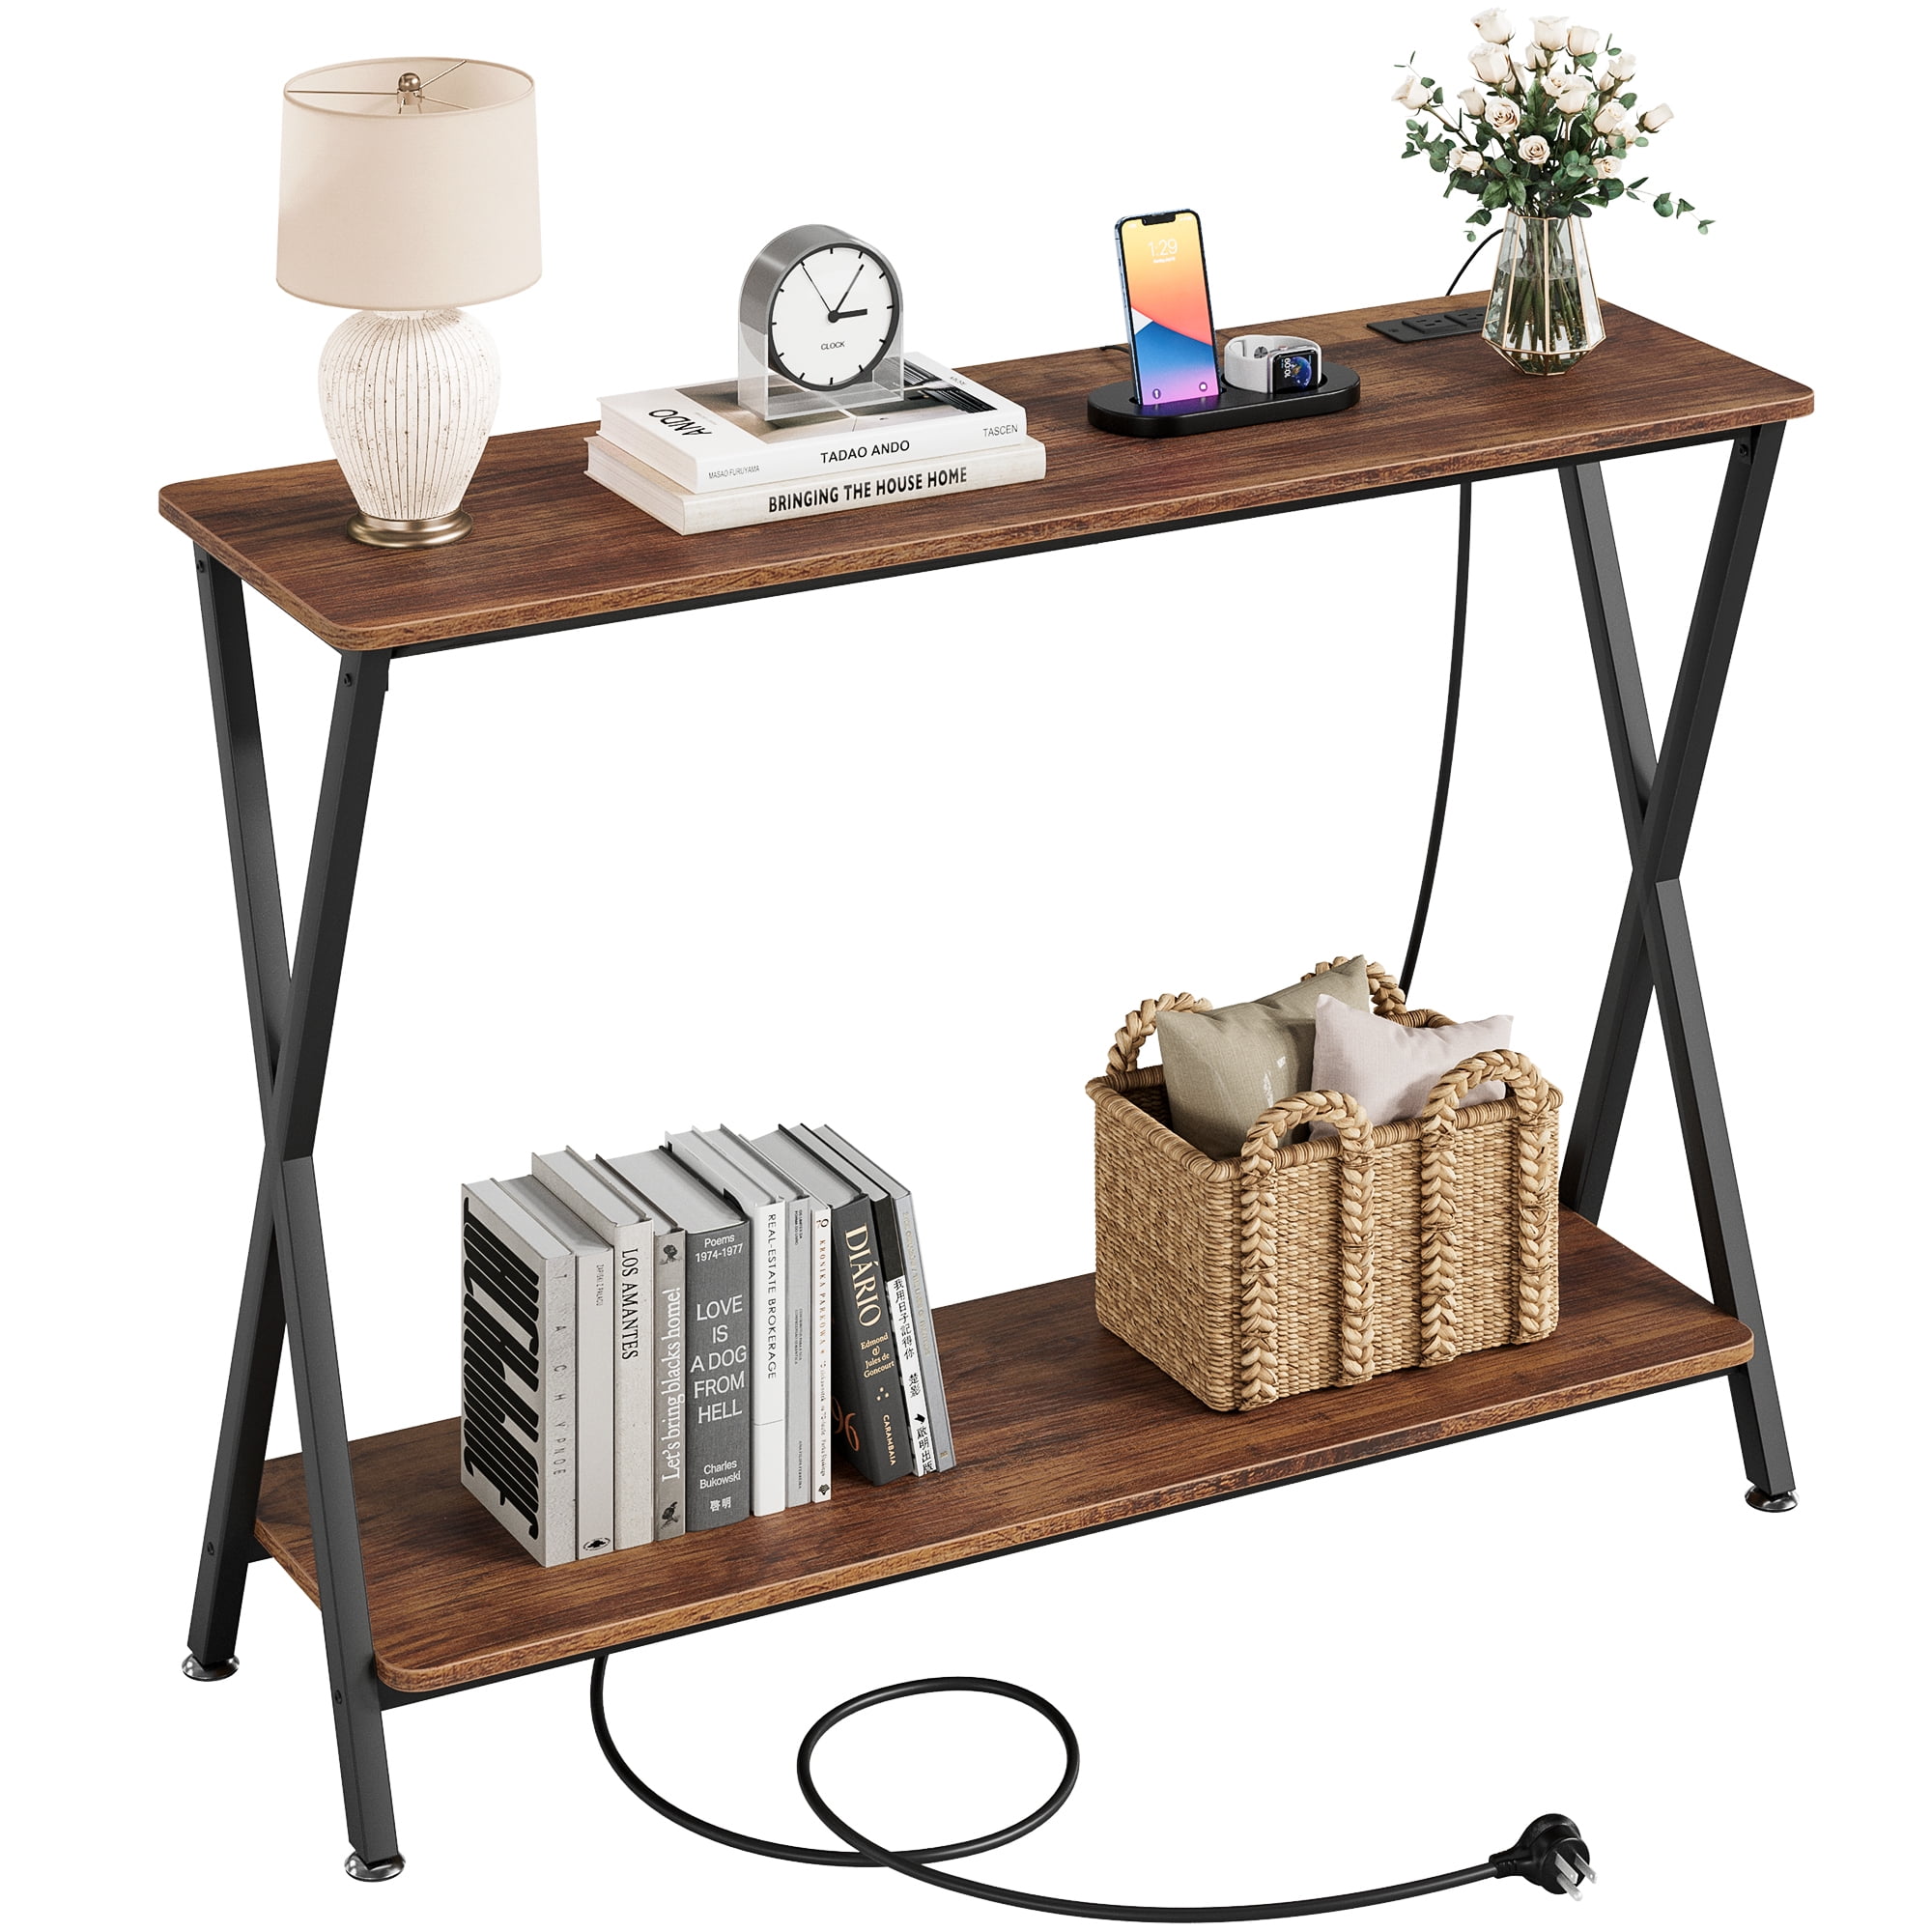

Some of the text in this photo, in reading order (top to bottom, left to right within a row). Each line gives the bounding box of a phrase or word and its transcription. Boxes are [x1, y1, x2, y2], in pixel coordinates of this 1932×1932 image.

[1147, 239, 1179, 257] 1:29
[820, 341, 845, 351] CLOCK
[648, 409, 713, 436] ANDO
[982, 424, 1018, 437] TASCEN
[820, 440, 910, 464] TADAO ANDO
[708, 469, 729, 479] MASAO
[768, 467, 967, 513] BRINGING THE HOUSE HOME
[695, 1242, 743, 1263] 1974-1977
[704, 1234, 735, 1248] Poems
[844, 1222, 881, 1328] DIÁRIO
[621, 1248, 639, 1360] LOS AMANTES
[696, 1294, 743, 1321] LOVE
[767, 1213, 777, 1379] REAL-ESTATE BROKERAGE
[661, 1287, 681, 1341] home!
[712, 1324, 728, 1344] IS
[861, 1332, 889, 1350] Edmond
[661, 1341, 680, 1395] blacks
[690, 1345, 747, 1373] A DOG
[864, 1360, 895, 1378] Goncourt
[865, 1352, 890, 1370] Jules de
[694, 1370, 745, 1399] FROM
[661, 1393, 685, 1441] bring
[697, 1399, 743, 1424] HELL
[883, 1413, 897, 1466] CARAMBAIA
[703, 1460, 737, 1475] Charles
[699, 1470, 741, 1490] Bukowski
